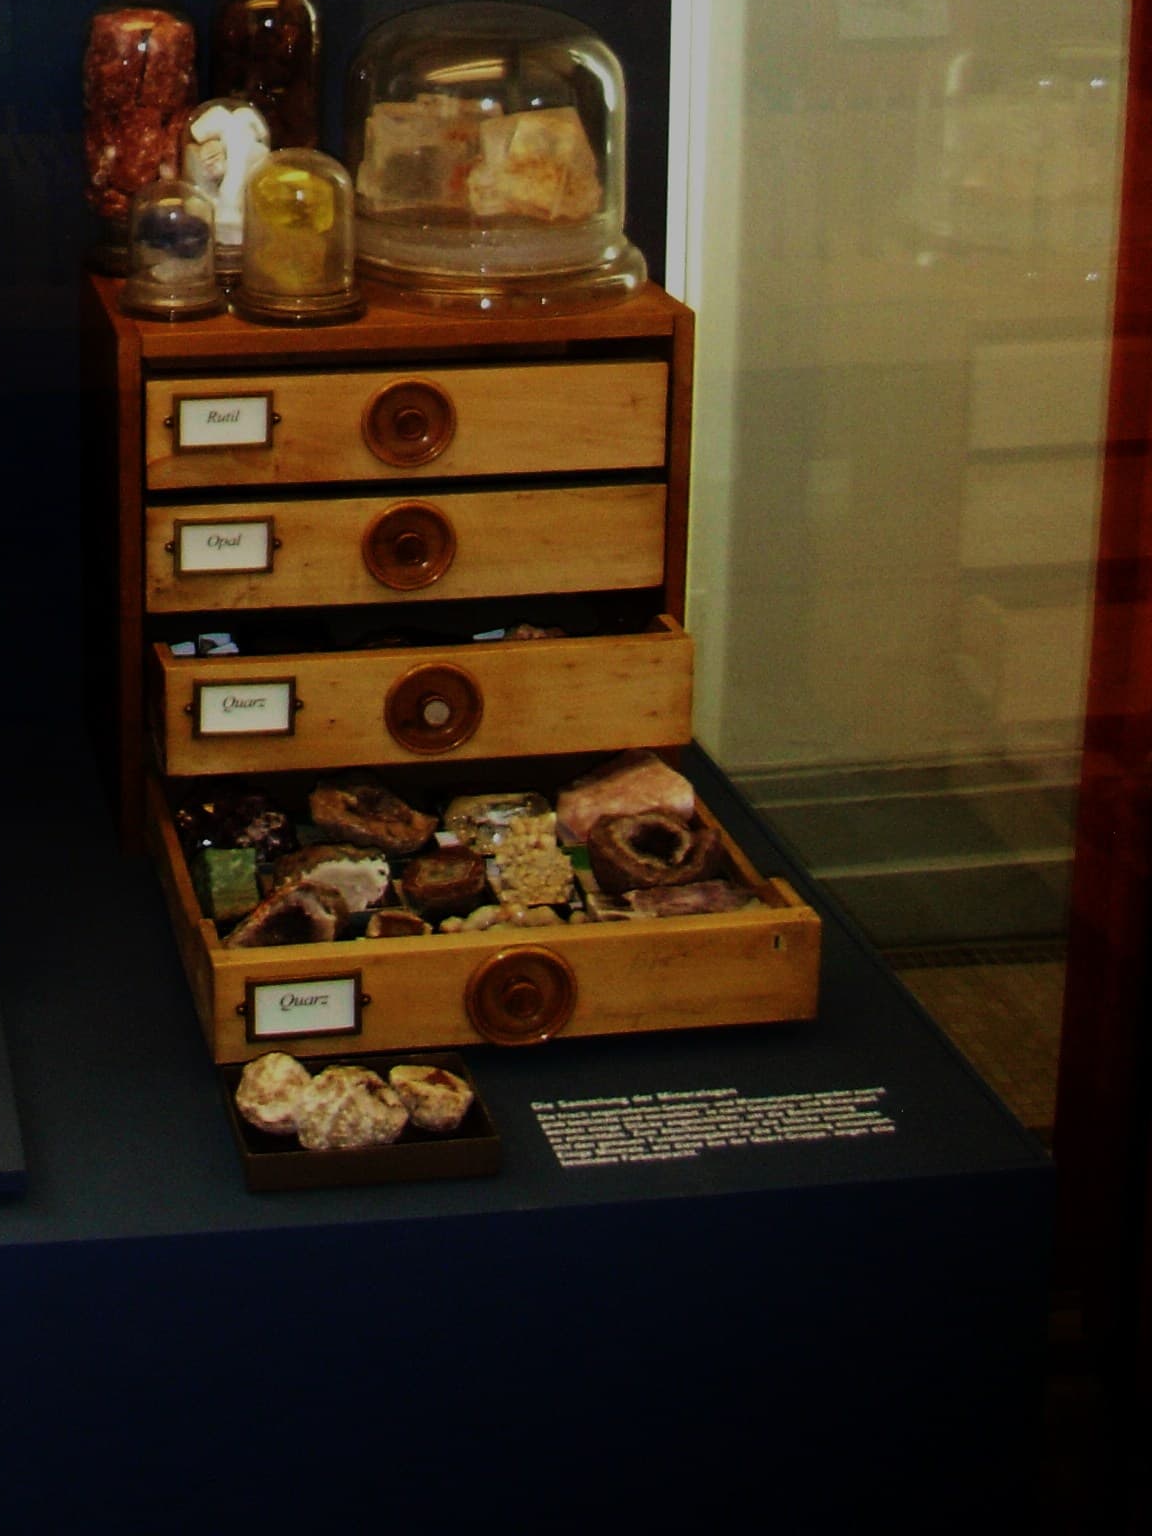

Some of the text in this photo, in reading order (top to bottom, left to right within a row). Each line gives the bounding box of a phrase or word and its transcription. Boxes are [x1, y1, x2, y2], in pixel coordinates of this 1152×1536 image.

[208, 410, 240, 423] Rutil
[207, 534, 241, 550] Opal
[223, 695, 266, 712] Quarz
[280, 993, 330, 1011] Quarz
